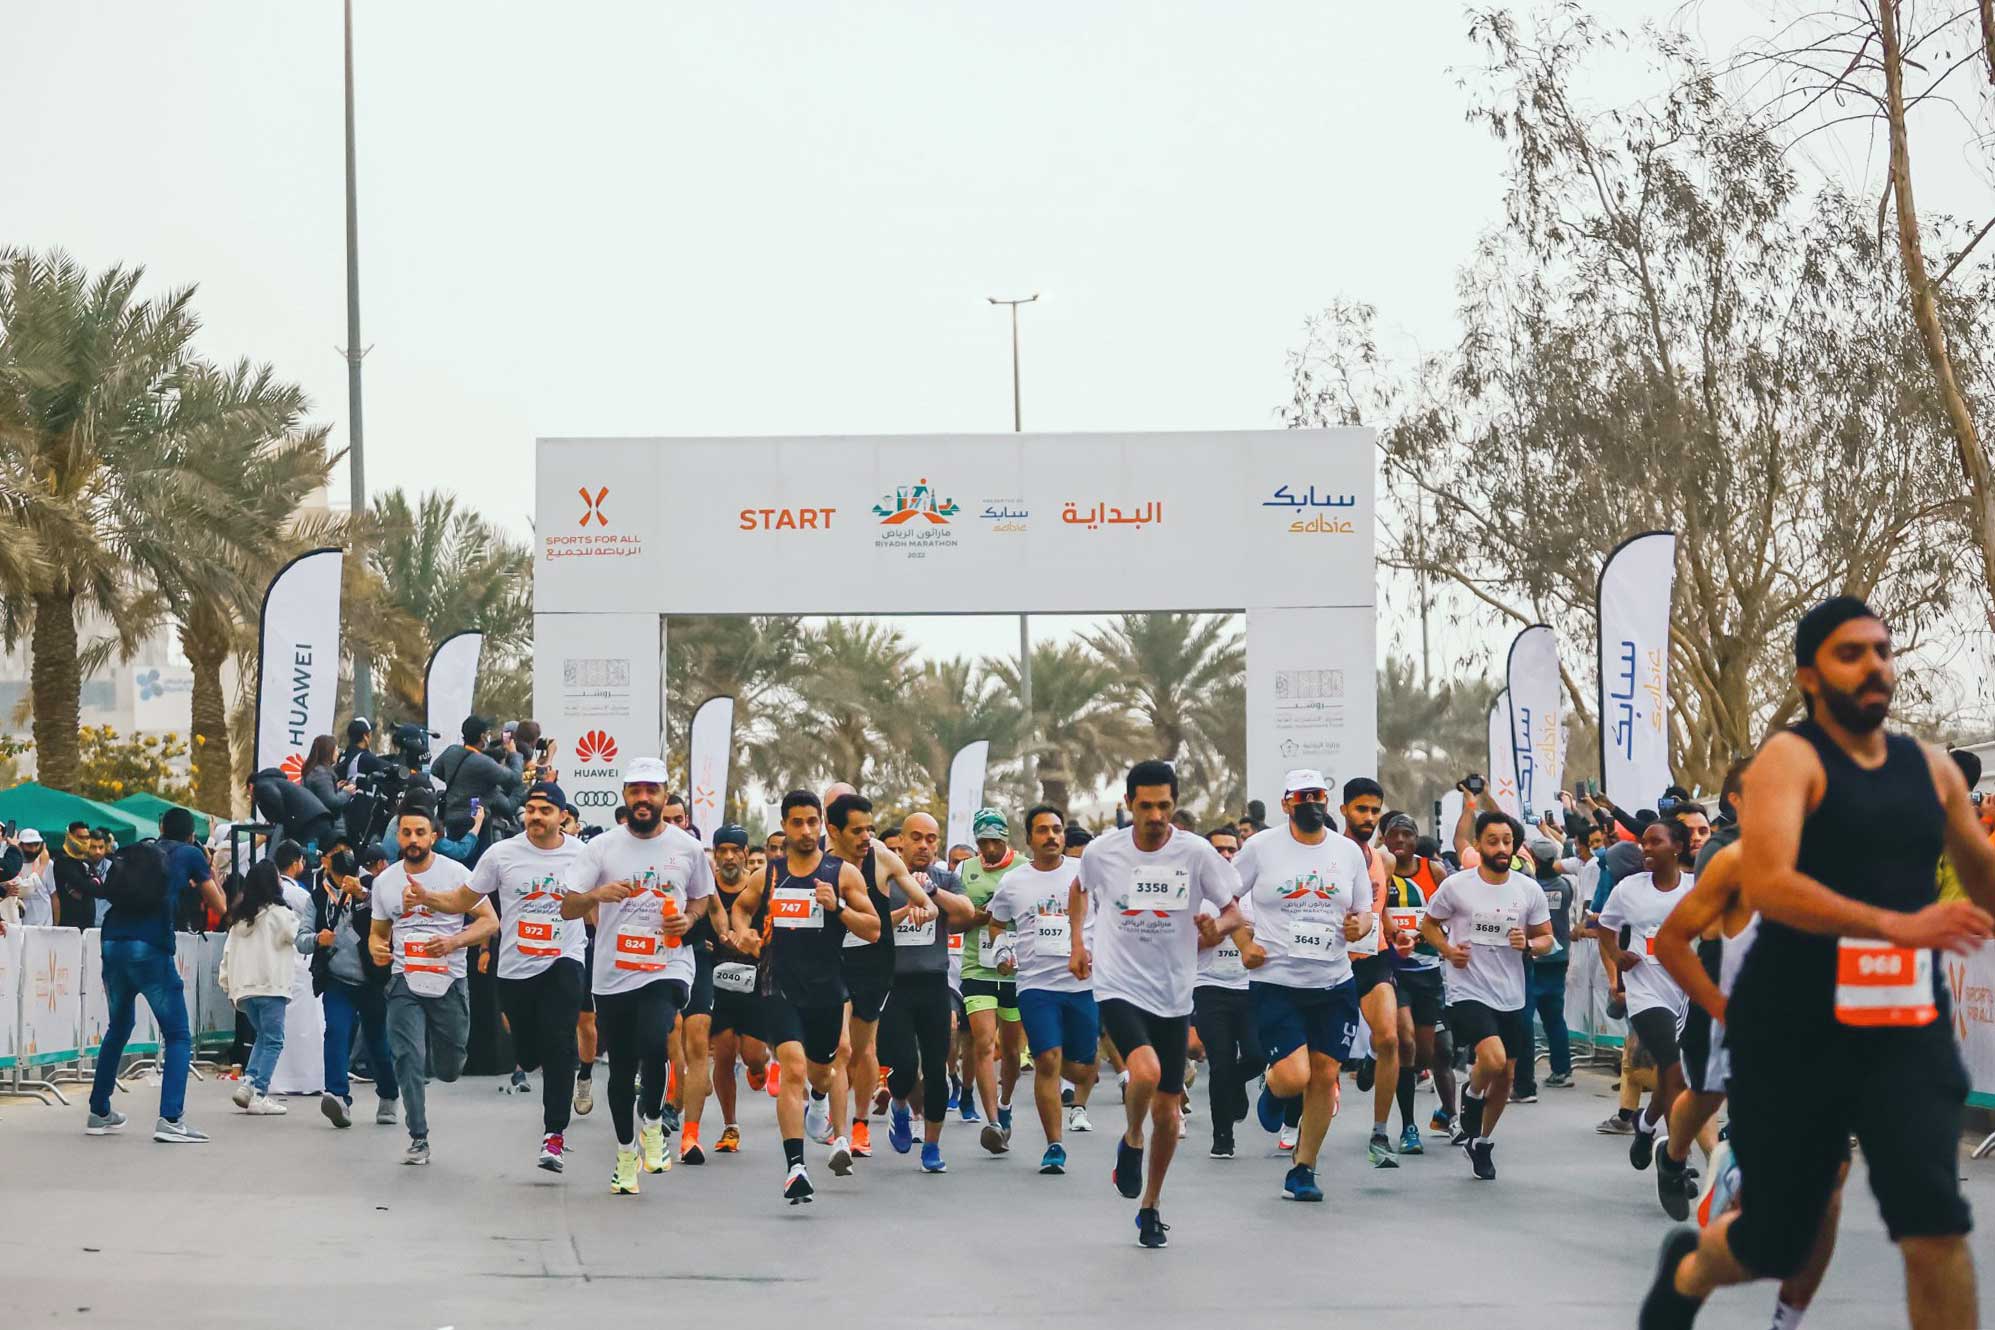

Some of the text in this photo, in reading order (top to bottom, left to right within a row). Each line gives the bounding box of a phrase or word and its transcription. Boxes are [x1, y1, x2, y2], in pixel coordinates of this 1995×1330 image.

[739, 508, 836, 530] START
[1062, 502, 1161, 530] البداية
[881, 528, 914, 539] الرياض
[545, 535, 641, 545] SPORTS FOR ALL
[289, 643, 312, 746] HUAWEI
[574, 769, 619, 778] HUAWEI
[1136, 882, 1169, 893] 3358
[780, 903, 801, 912] 747
[524, 926, 543, 936] 972
[1039, 928, 1063, 937] 3037
[1475, 923, 1501, 933] 3689
[624, 939, 646, 949] 824
[1294, 934, 1320, 945] 3643
[716, 971, 741, 981] 2040
